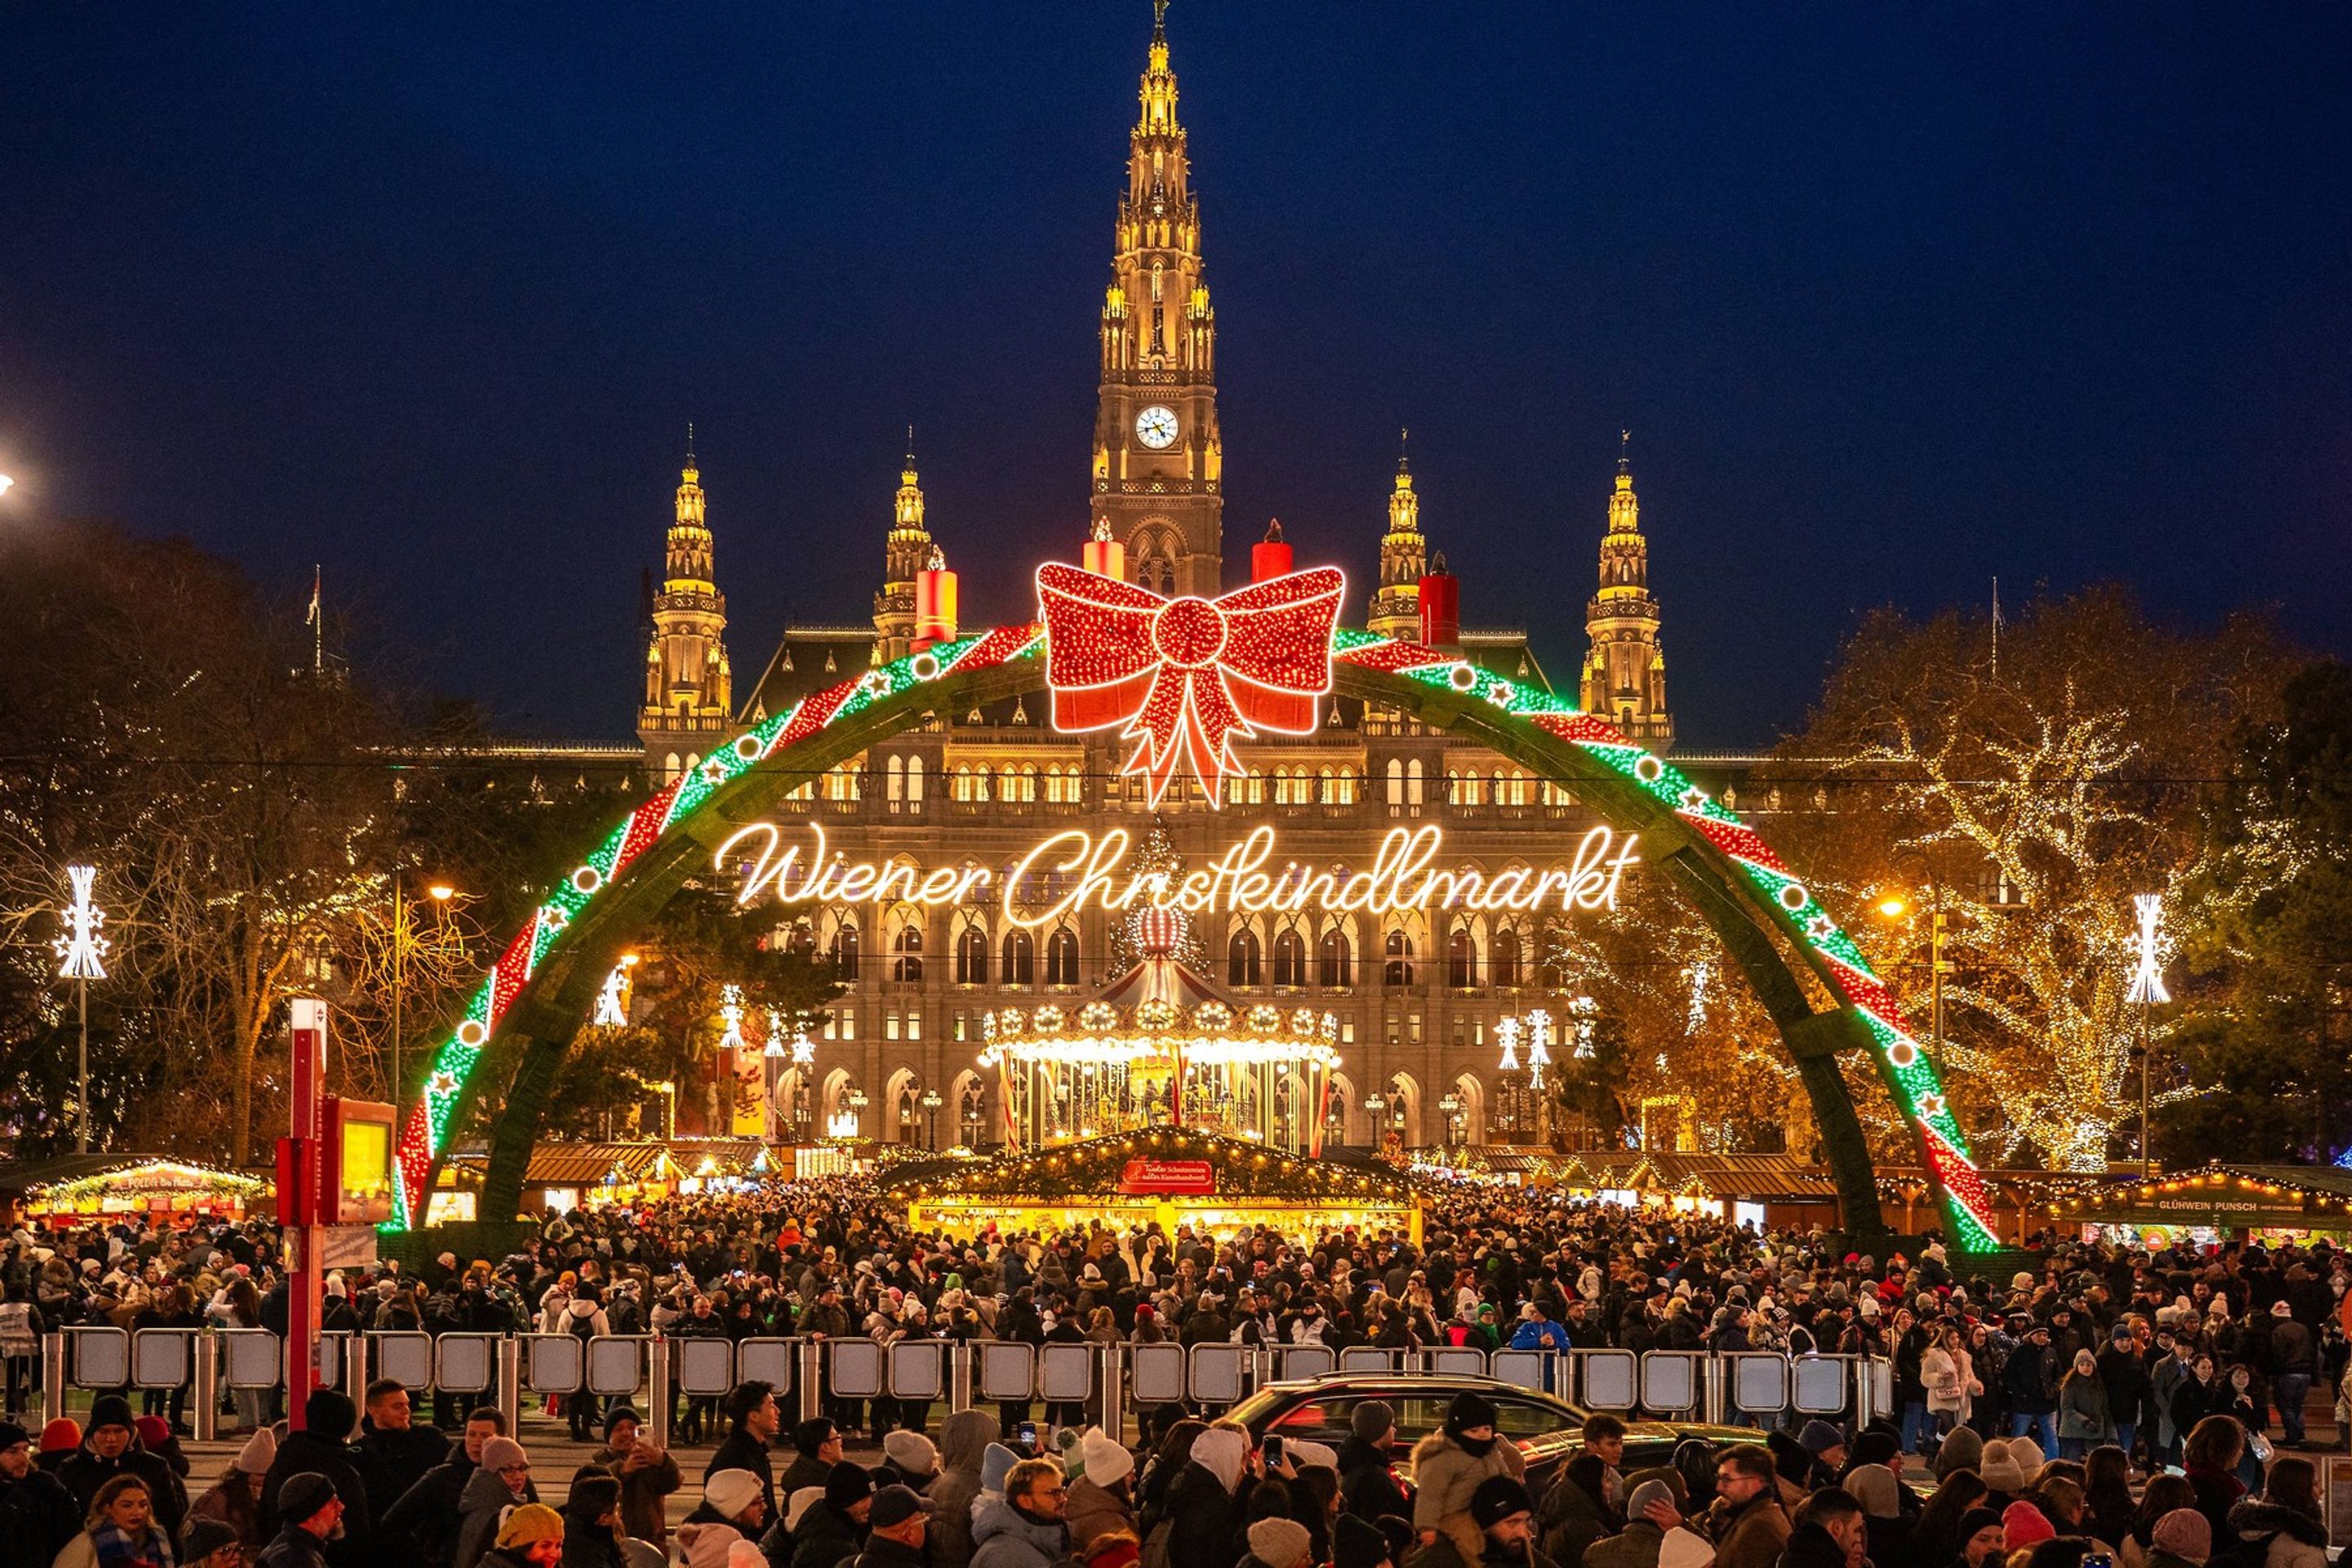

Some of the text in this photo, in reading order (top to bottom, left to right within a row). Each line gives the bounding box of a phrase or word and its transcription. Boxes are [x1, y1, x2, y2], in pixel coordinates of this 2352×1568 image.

[715, 822, 1642, 928] Wiener Christkindlmarkt
[2158, 1200, 2211, 1210] GLÜHWEIN
[2215, 1202, 2256, 1211] PUNSCH
